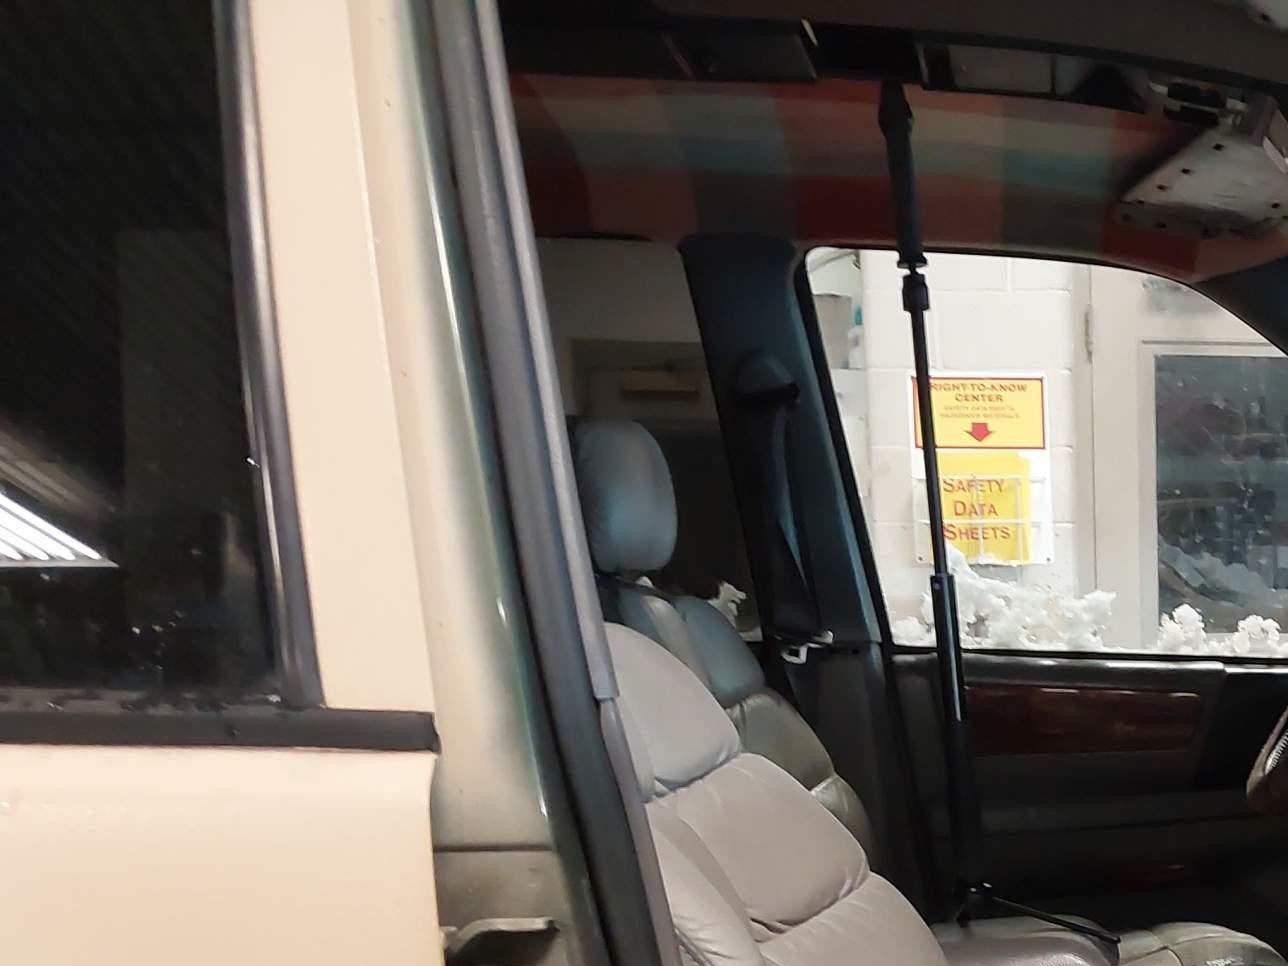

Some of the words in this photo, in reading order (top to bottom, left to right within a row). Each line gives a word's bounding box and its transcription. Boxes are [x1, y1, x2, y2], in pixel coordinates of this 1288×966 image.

[955, 393, 1004, 402] CENTER
[943, 478, 1005, 493] SAFETY
[954, 501, 999, 517] DATA
[943, 523, 1011, 541] SHEETS
